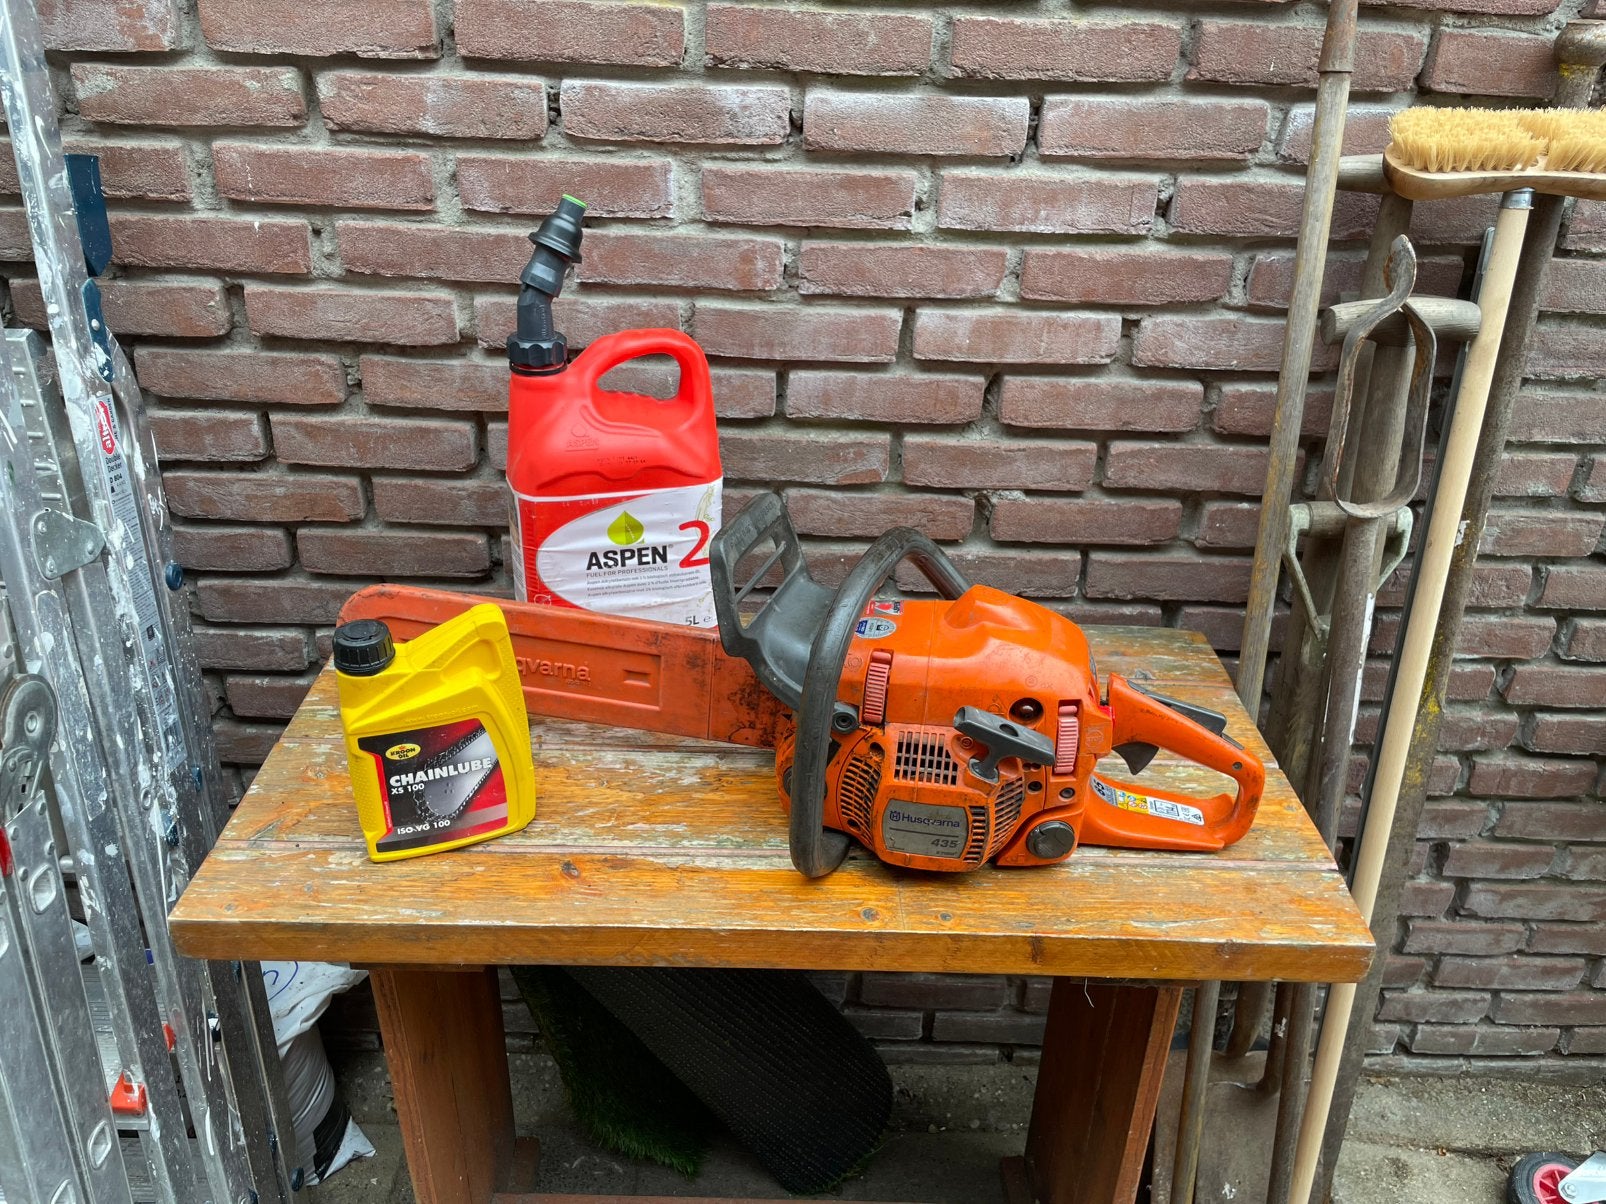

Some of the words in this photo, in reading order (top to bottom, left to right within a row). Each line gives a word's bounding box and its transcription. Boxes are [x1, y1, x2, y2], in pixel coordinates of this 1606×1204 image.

[678, 520, 710, 569] 2
[585, 545, 668, 571] ASPEN
[617, 566, 669, 575] PROFESSIONALS
[685, 616, 700, 626] 5L
[390, 747, 416, 756] KROON
[389, 757, 492, 787] CHAINLUBE
[391, 787, 404, 795] XS
[407, 783, 425, 792] 100
[433, 819, 451, 829] 100
[901, 812, 960, 828] Husqvarna
[930, 838, 959, 849] 435
